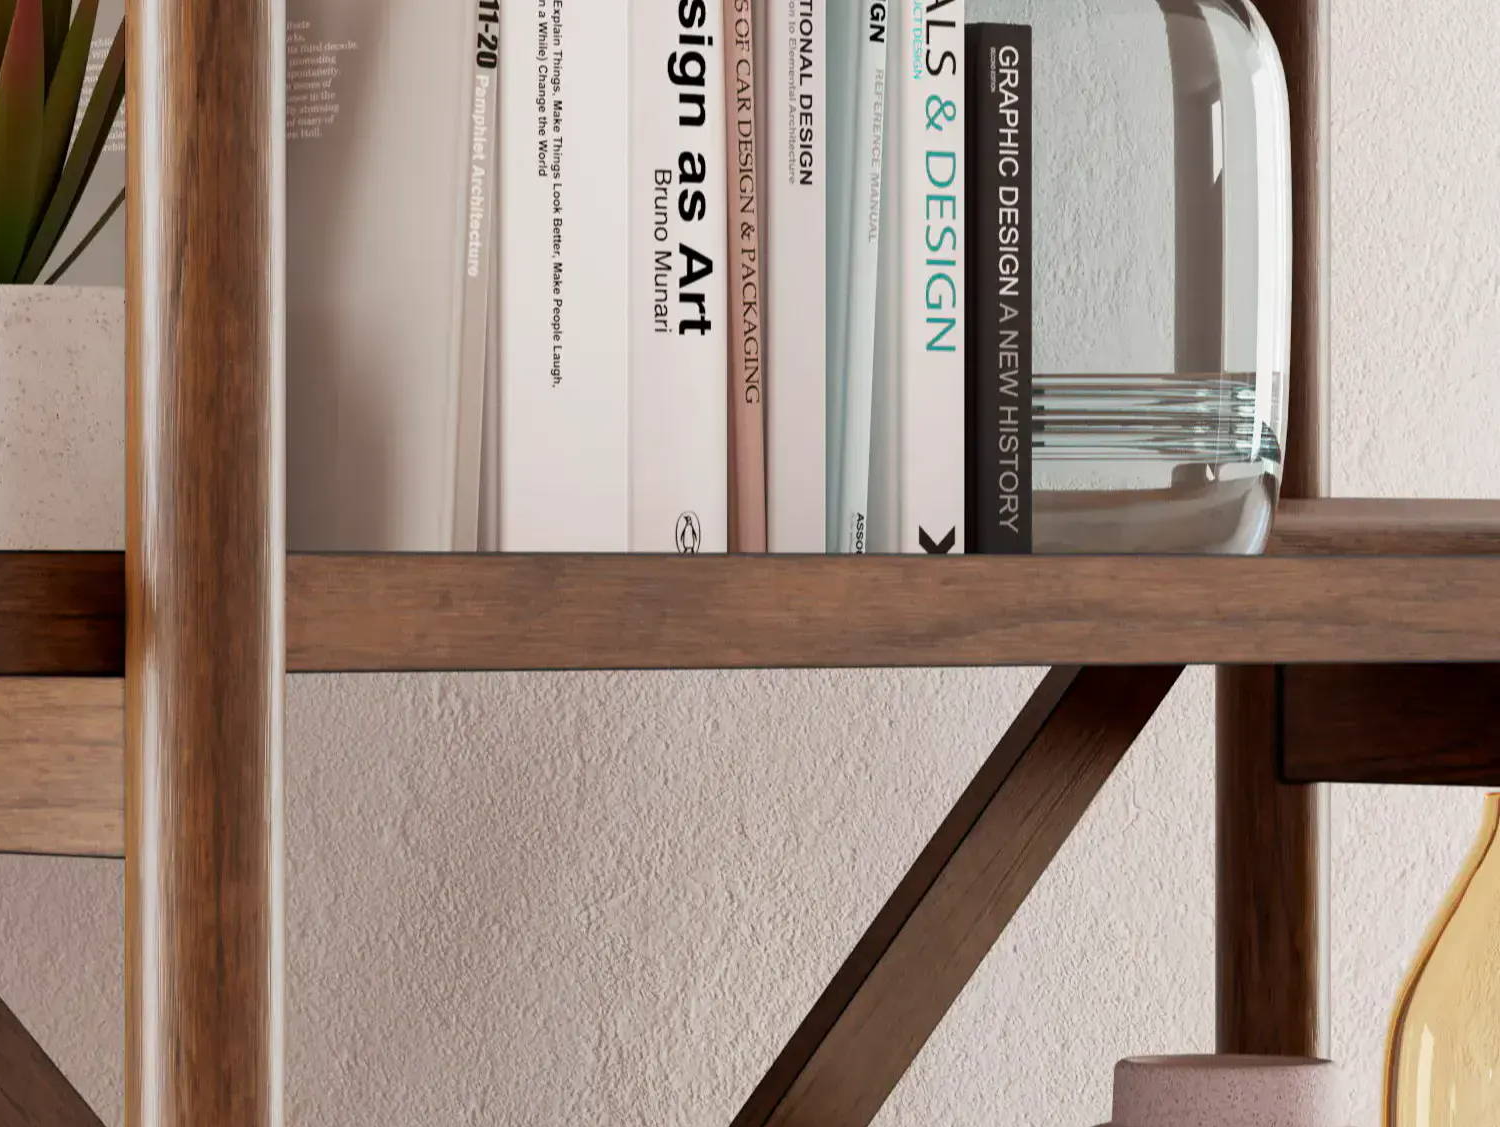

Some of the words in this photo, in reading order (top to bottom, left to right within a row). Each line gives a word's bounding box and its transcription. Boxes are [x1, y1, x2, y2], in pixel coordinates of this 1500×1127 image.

[476, 0, 500, 69] 11-20
[536, 22, 548, 61] While)
[551, 0, 563, 47] Explain
[735, 18, 750, 52] OF
[788, 21, 796, 33] to
[799, 0, 813, 86] TIONAL
[869, 0, 886, 43] GN
[551, 51, 563, 96] Things,
[788, 38, 797, 101] Elemental
[912, 27, 923, 79] DESIGN
[536, 65, 548, 113] Change
[736, 59, 751, 112] CAR
[998, 45, 1019, 177] GRAPHIC
[472, 75, 489, 161] Pamphlet
[538, 117, 548, 136] the
[553, 100, 563, 133] Make
[872, 68, 885, 167] REFERENCE
[925, 94, 956, 131] &
[538, 140, 548, 177] World
[551, 137, 563, 179] Things
[788, 104, 797, 185] Architecture
[799, 94, 813, 186] DESIGN
[678, 151, 706, 222] as
[737, 120, 755, 214] DESIGN
[467, 165, 486, 277] Architecture
[553, 183, 563, 213] Look
[654, 169, 672, 242] Bruno
[868, 172, 883, 243] MANUAL
[551, 218, 563, 258] Better,
[740, 221, 755, 240] &
[925, 150, 956, 352] DESIGN
[998, 186, 1019, 295] DESIGN
[553, 262, 563, 295] Make
[654, 251, 672, 333] Munari
[679, 242, 713, 335] Art
[551, 299, 563, 341] People
[741, 248, 760, 404] PACKAGING
[999, 303, 1019, 323] A
[550, 345, 563, 388] Laugh,
[998, 330, 1019, 397] NEW
[999, 406, 1019, 534] HISTORY
[856, 512, 864, 553] ASSO
